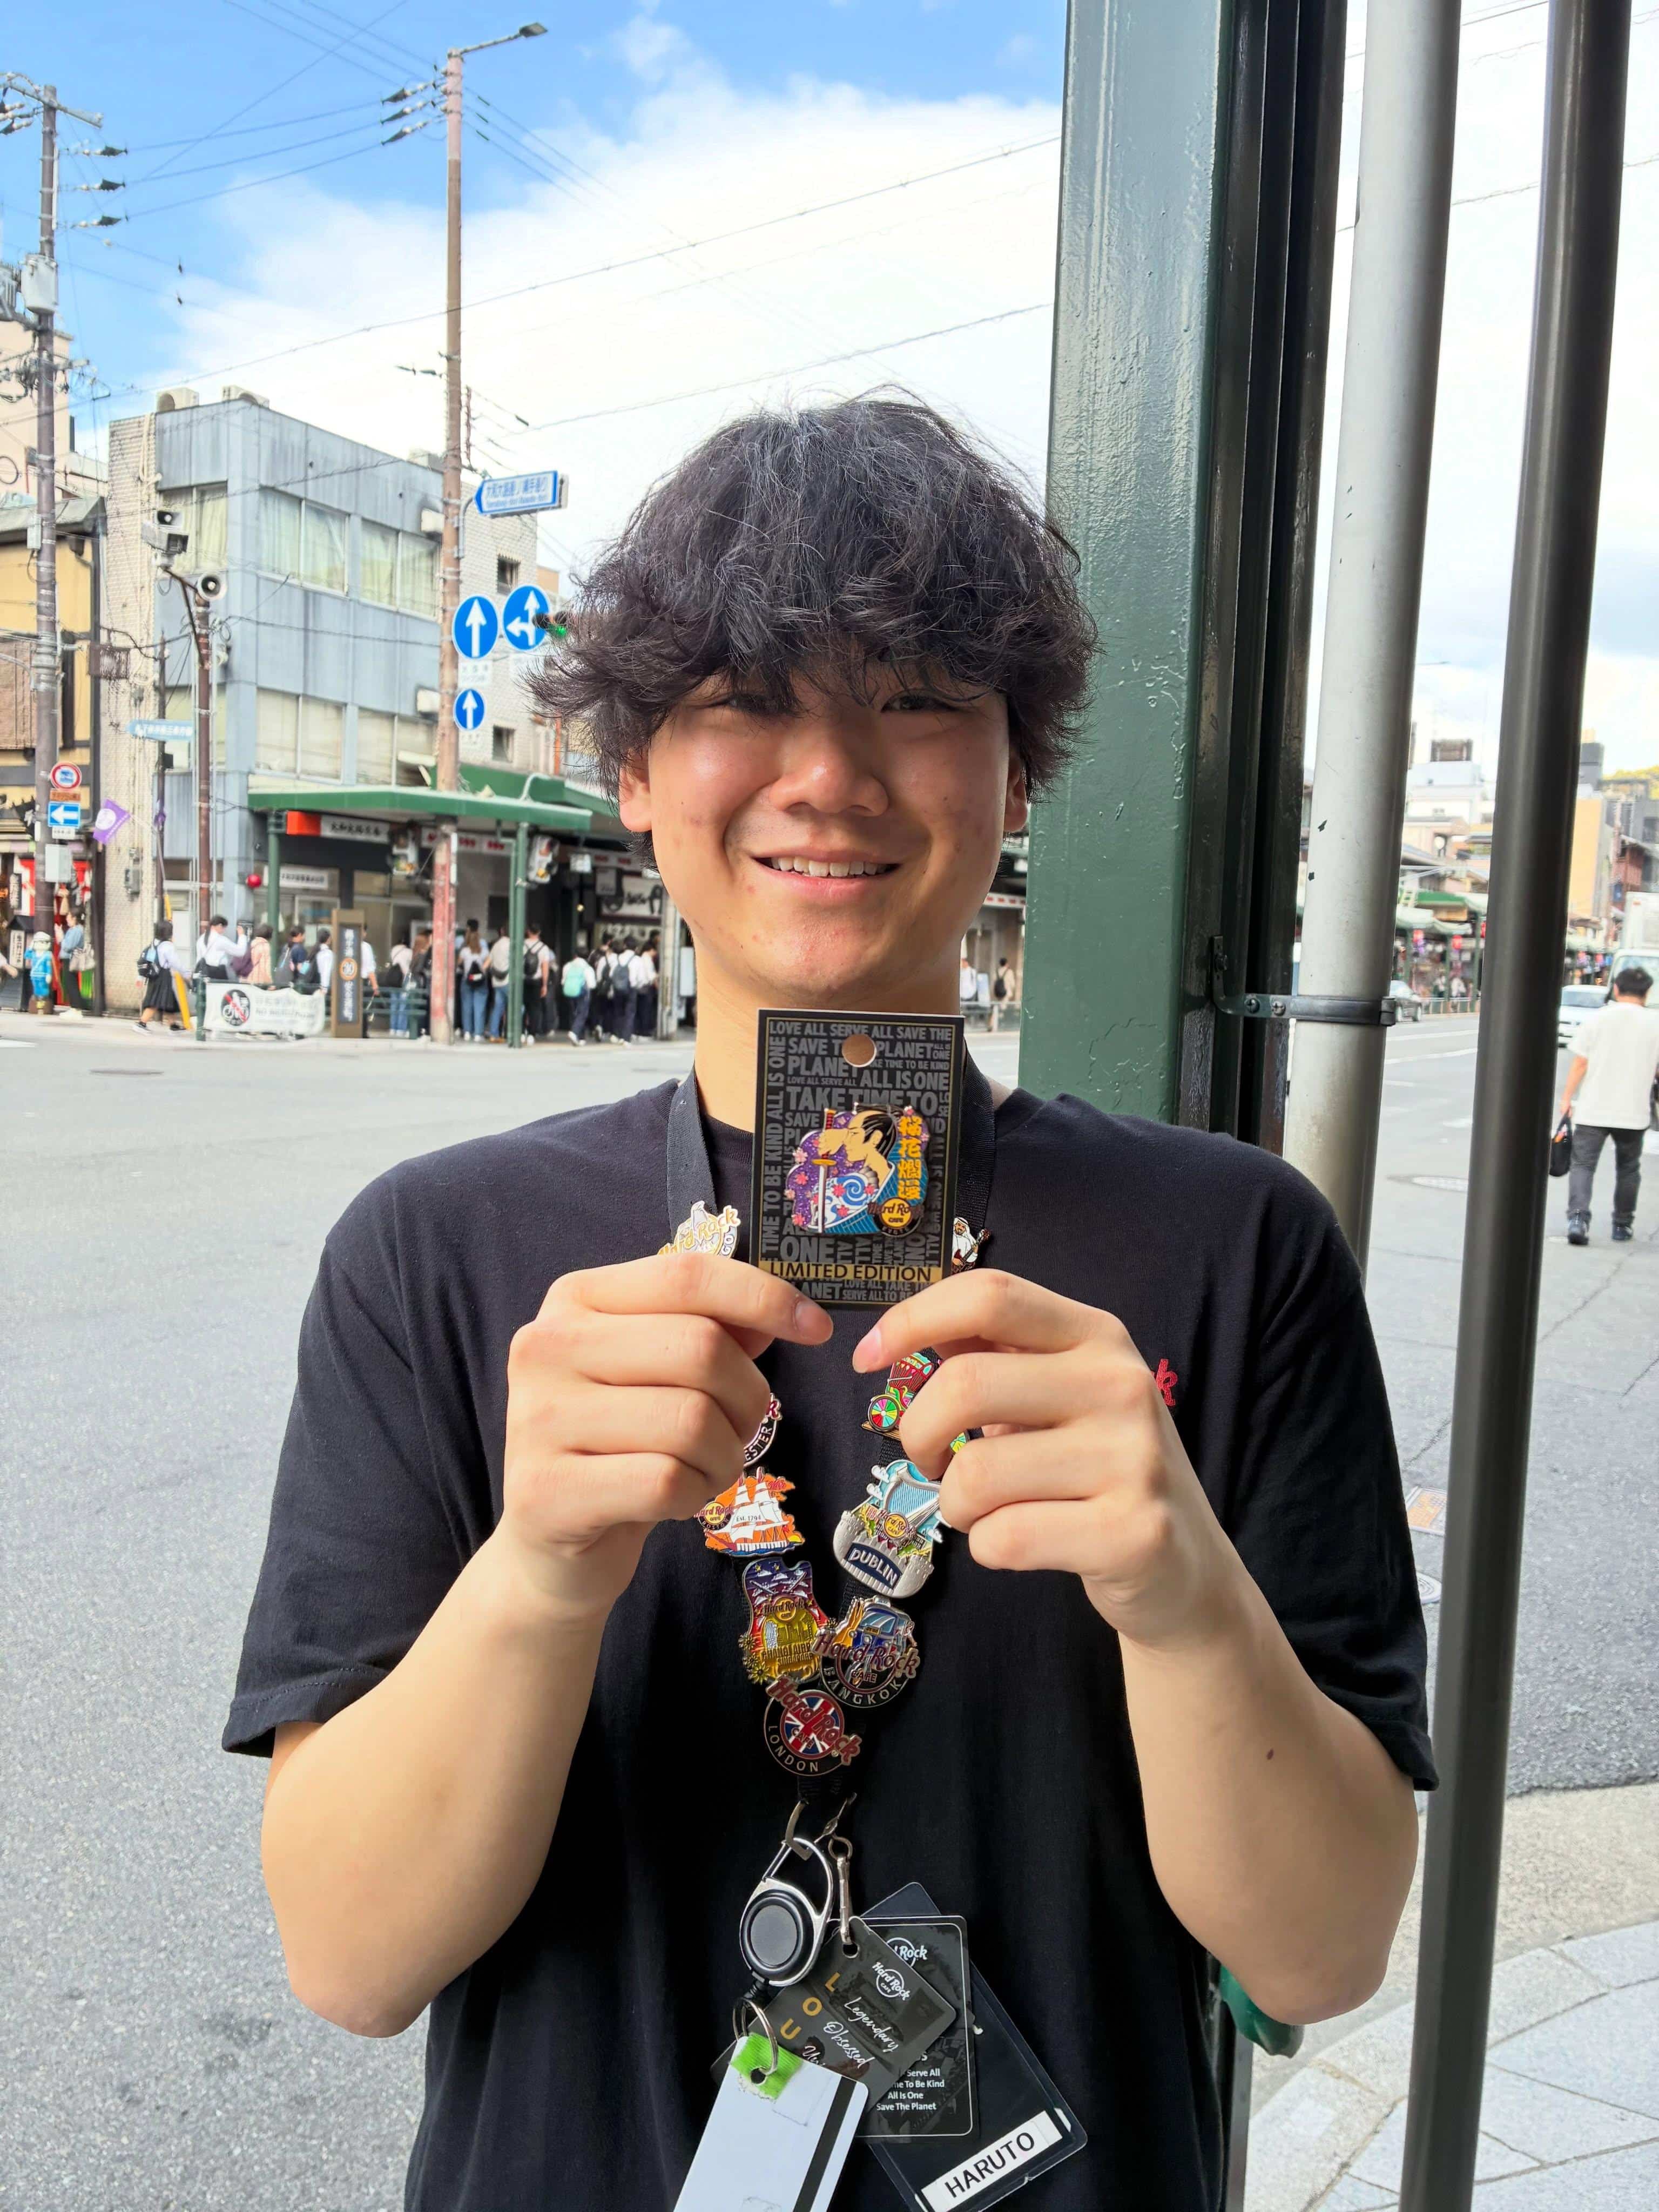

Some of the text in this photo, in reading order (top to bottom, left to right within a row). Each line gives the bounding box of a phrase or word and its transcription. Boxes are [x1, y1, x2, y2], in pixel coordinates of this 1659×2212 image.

[770, 1021, 801, 1035] LOVE
[804, 1023, 827, 1036] ALL
[872, 1025, 894, 1038] ALL
[896, 1027, 926, 1040] SAVE
[928, 1028, 952, 1041] THE
[788, 1037, 828, 1055] SAVE
[876, 1041, 933, 1059] PLANET
[905, 1061, 916, 1069] TO
[860, 1070, 949, 1090] ALL IS ONE
[786, 1086, 846, 1112] TAKE
[907, 1091, 938, 1116] TO
[785, 1112, 820, 1128] SAVE
[780, 1236, 835, 1263] ONE
[771, 1262, 931, 1282] LIMITED EDITION
[848, 1548, 898, 1586] DUBLIN
[813, 1633, 919, 1676] Hard Rock
[824, 1667, 902, 1705] BANGKOK
[769, 1726, 819, 1772] LONDON
[899, 1945, 928, 1961] Rock
[872, 1961, 911, 2001] Hard Rock
[844, 1997, 899, 2053] Legendary
[929, 2068, 940, 2076] All
[927, 2079, 945, 2088] Kind
[888, 2091, 898, 2099] All
[945, 2132, 1035, 2198] HARUTO
